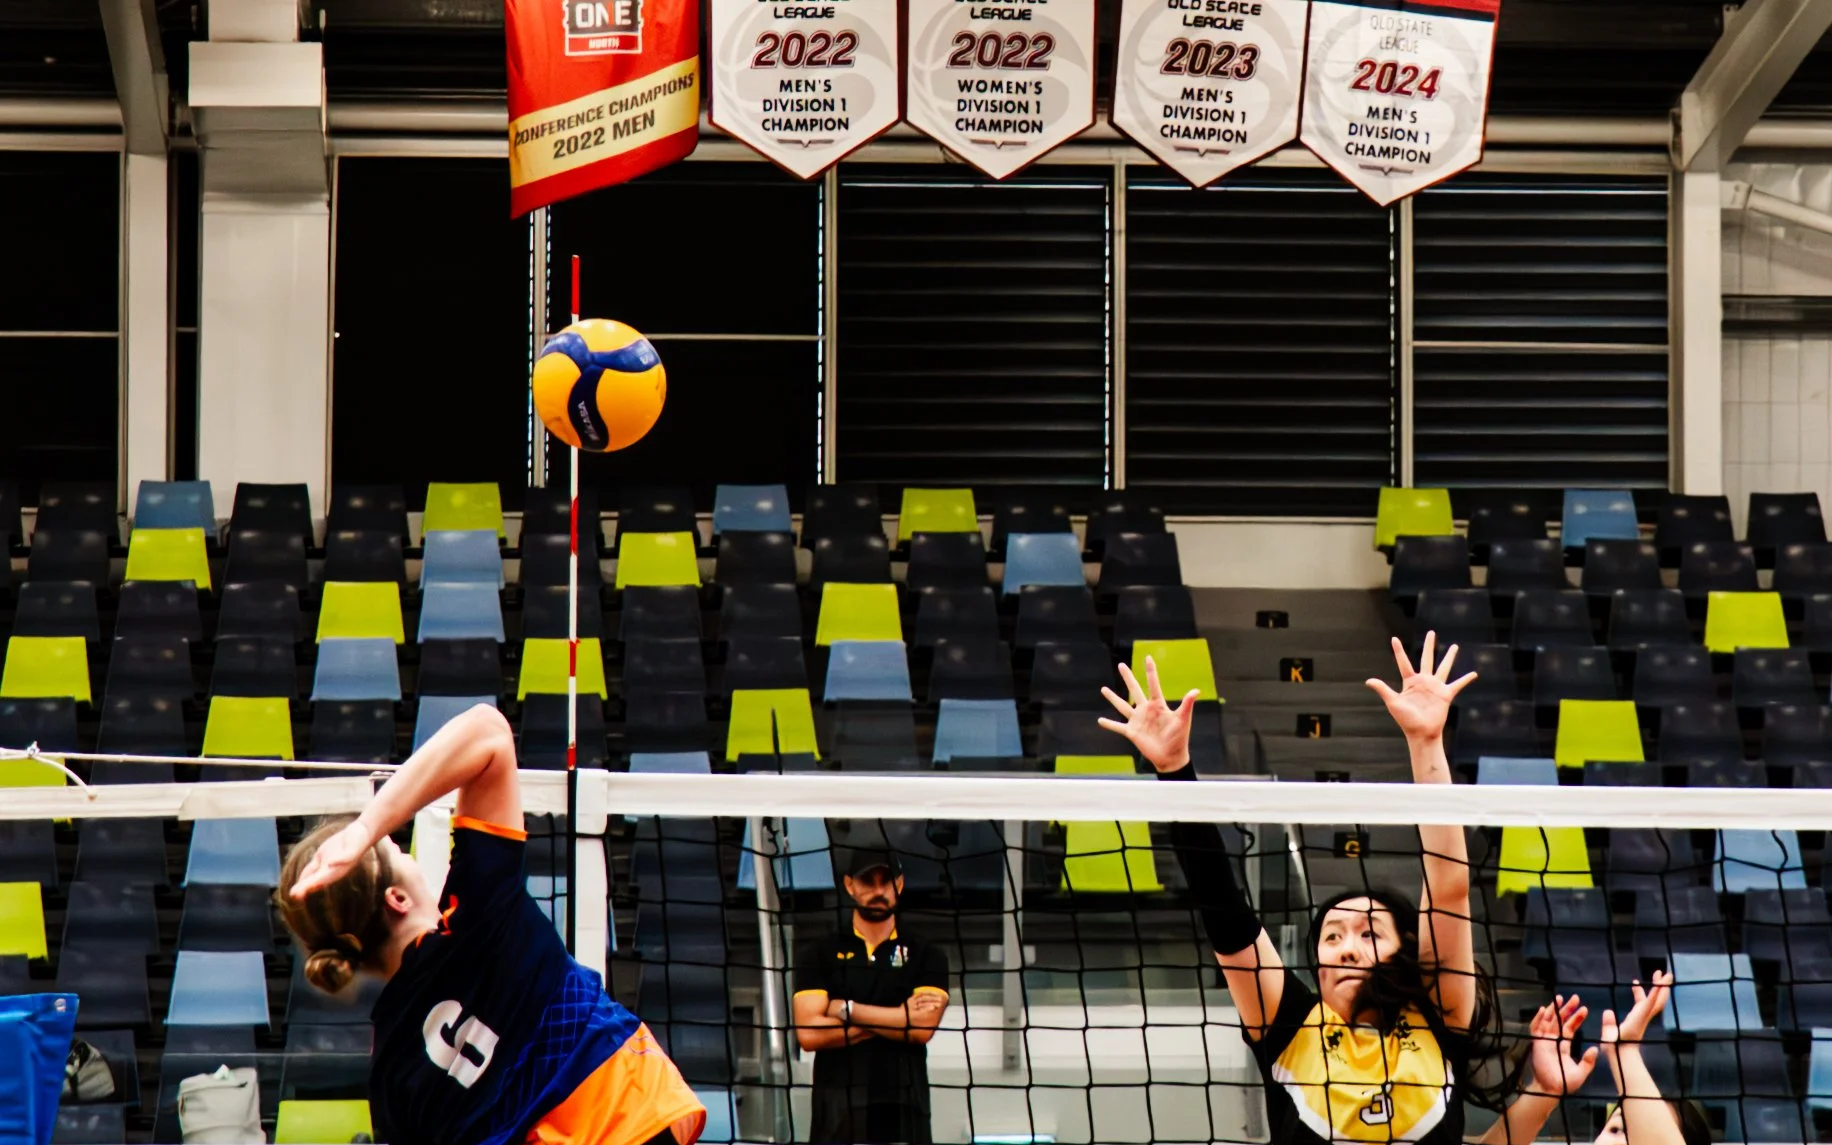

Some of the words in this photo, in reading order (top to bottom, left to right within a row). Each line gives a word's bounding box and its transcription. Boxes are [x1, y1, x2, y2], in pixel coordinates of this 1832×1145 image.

[575, 0, 632, 28] ONE
[773, 6, 835, 19] LEAGUE
[970, 7, 1033, 20] LEAGUE
[1182, 14, 1244, 31] LEAGUE
[1397, 18, 1433, 36] STATE
[751, 29, 860, 69] 2022
[946, 30, 1056, 71] 2022
[1160, 38, 1261, 80] 2023
[779, 79, 832, 93] MEN'S
[957, 79, 1043, 95] WOMEN'S
[1349, 58, 1443, 101] 2024
[1180, 87, 1233, 103] MEN'S
[514, 104, 604, 146] CONFERENCE
[608, 72, 694, 116] CHAMPIONS
[762, 98, 835, 112] DIVISION
[840, 97, 847, 112] 1
[957, 98, 1029, 114] DIVISION
[1035, 100, 1041, 115] 1
[1162, 107, 1235, 123] DIVISION
[1240, 111, 1247, 125] 1
[1366, 105, 1418, 124] MEN'S
[761, 117, 850, 132] CHAMPION
[955, 117, 1044, 133] CHAMPION
[1347, 122, 1418, 143] DIVISION
[1424, 131, 1431, 145] 1
[552, 127, 605, 160] 2022
[612, 109, 655, 140] MEN
[1160, 125, 1247, 144] CHAMPION
[1344, 141, 1431, 164] CHAMPION
[1290, 666, 1304, 684] K
[1309, 716, 1321, 740] J
[422, 999, 499, 1089] 6
